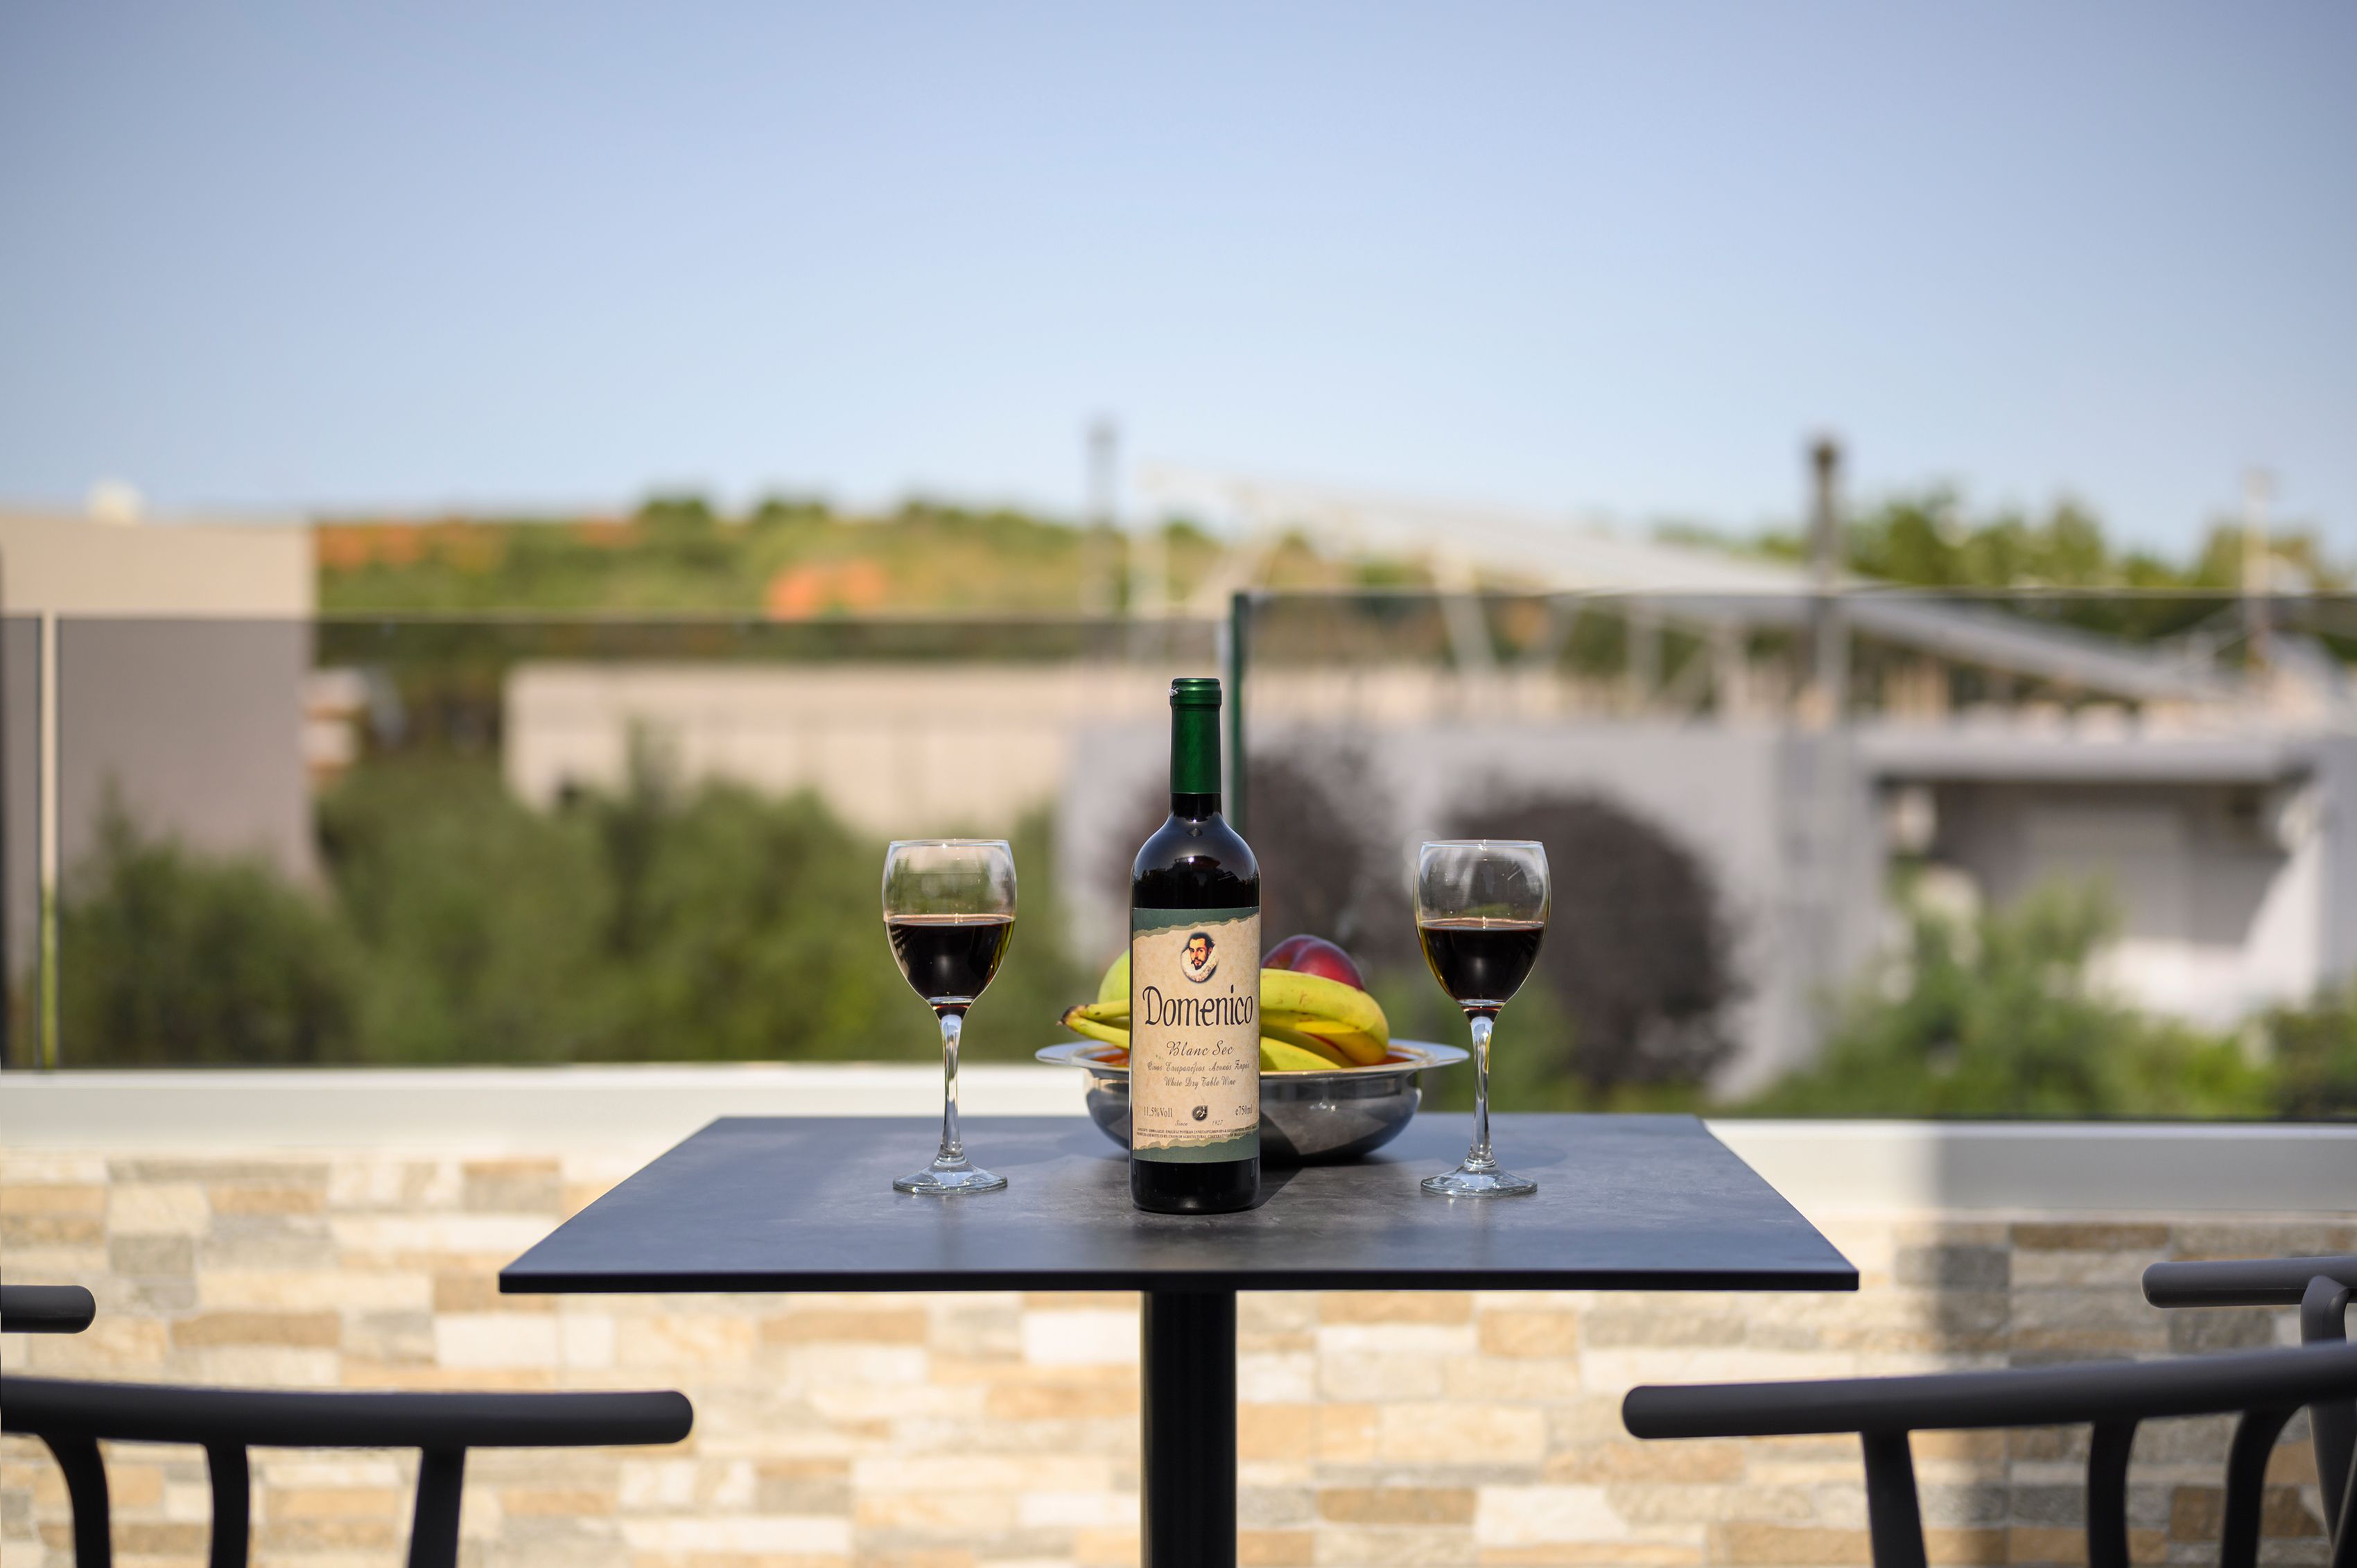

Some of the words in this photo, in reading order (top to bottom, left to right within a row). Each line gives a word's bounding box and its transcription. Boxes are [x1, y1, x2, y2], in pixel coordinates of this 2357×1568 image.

[1142, 984, 1253, 1027] Domenico
[1166, 1040, 1210, 1056] Blanc
[1212, 1040, 1234, 1056] Sec
[1164, 1077, 1183, 1087] White
[1185, 1077, 1199, 1090] Dry
[1201, 1077, 1220, 1087] Table
[1221, 1076, 1236, 1086] Wine
